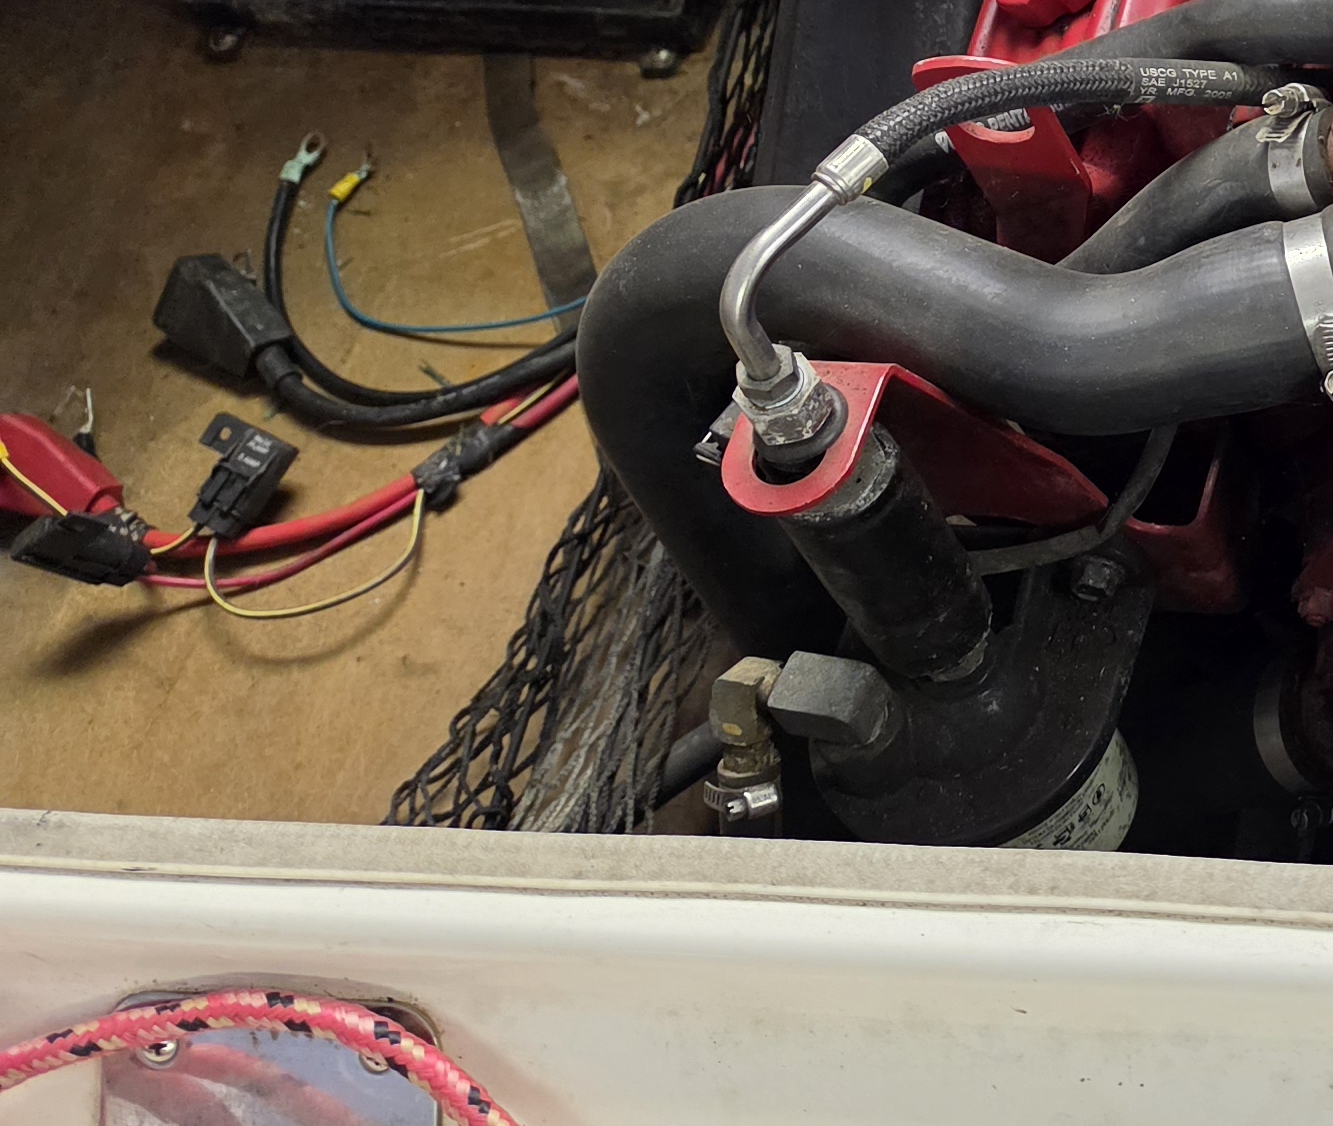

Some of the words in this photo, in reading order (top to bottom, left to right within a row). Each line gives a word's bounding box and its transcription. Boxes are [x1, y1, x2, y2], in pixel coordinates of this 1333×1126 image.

[1140, 67, 1177, 78] USCG
[1182, 68, 1217, 80] TYPE
[1222, 71, 1238, 81] A1
[1141, 77, 1166, 87] SAE
[1173, 79, 1208, 88] J1527
